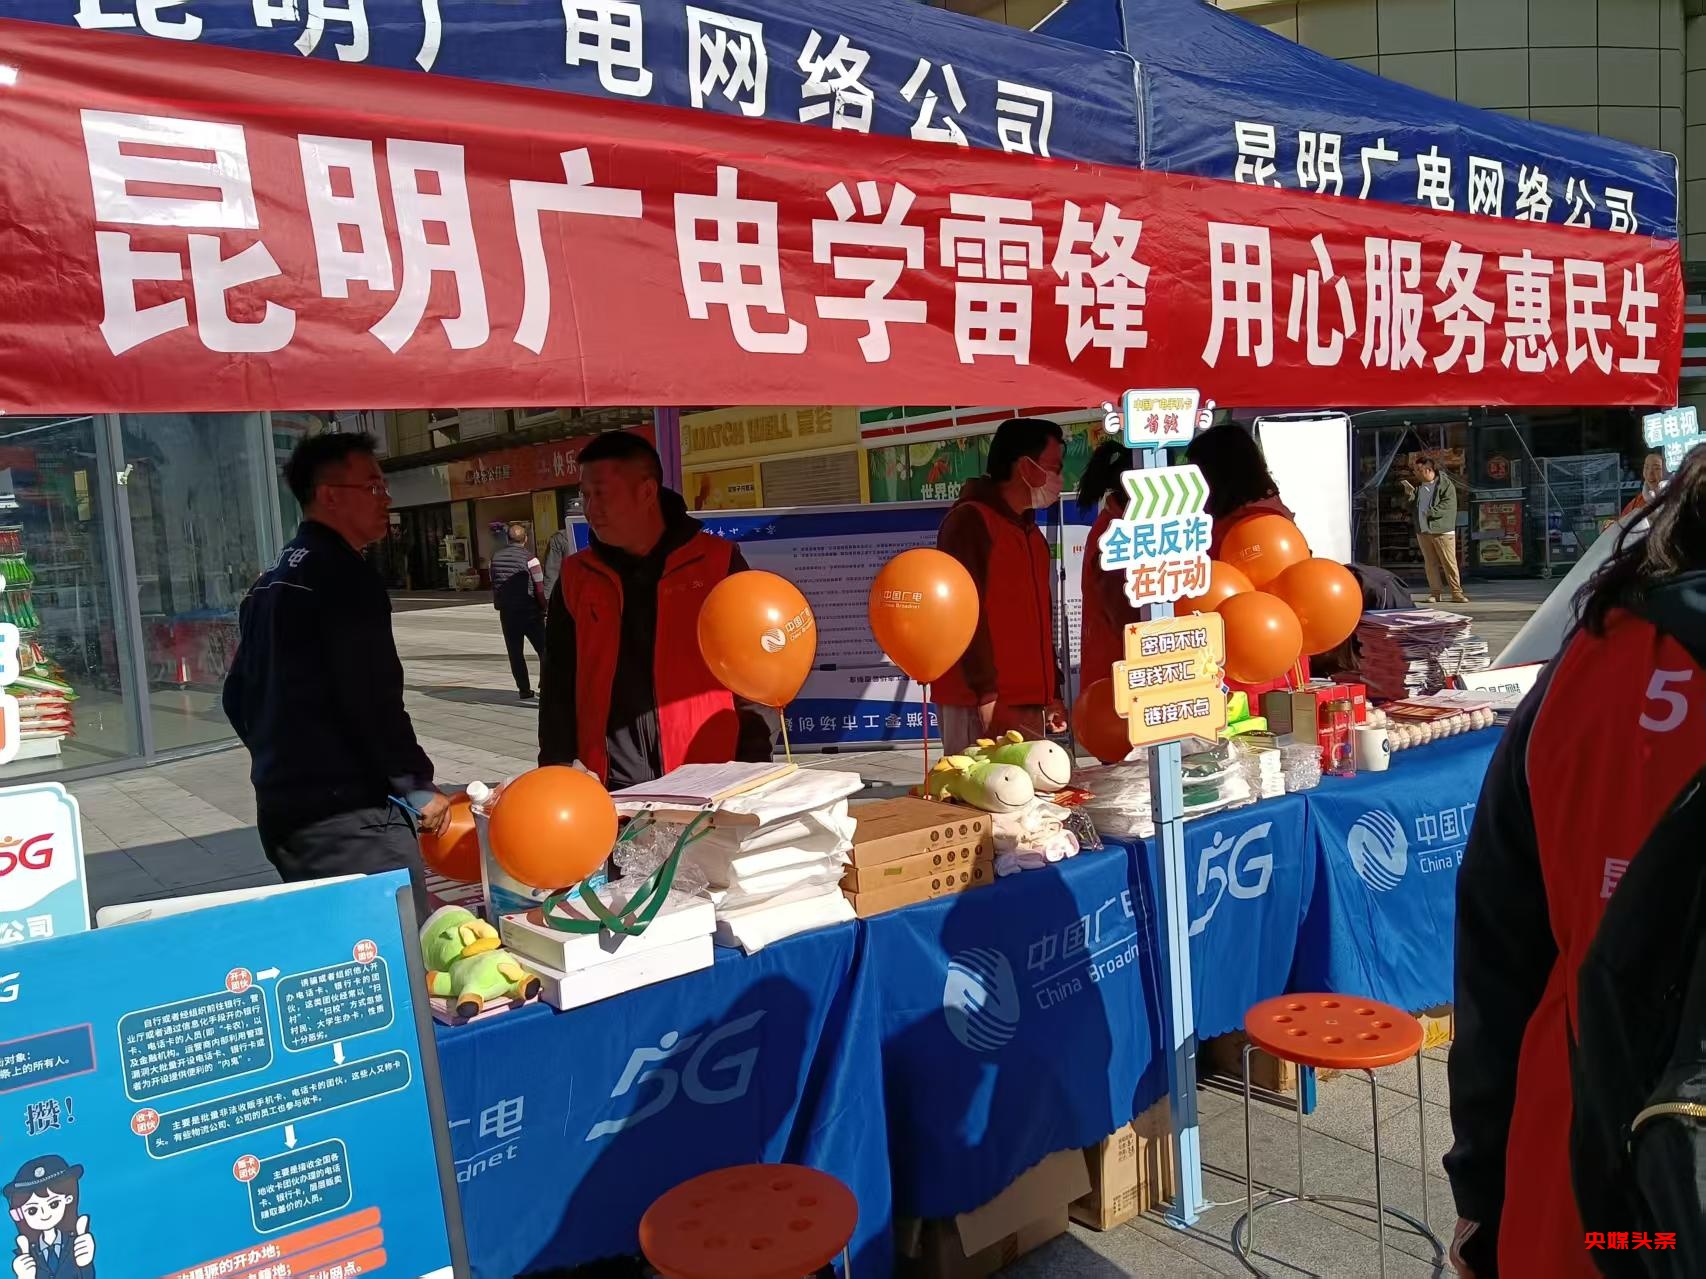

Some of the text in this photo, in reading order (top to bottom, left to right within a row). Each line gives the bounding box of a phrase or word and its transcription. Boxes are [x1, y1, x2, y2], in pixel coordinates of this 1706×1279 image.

[1235, 120, 1637, 236] 昆明广电网络公司
[80, 108, 1662, 376] 昆明广电学雷锋 用心服务惠民生
[1144, 413, 1180, 434] 省钱
[1646, 410, 1697, 443] 看电视
[1105, 516, 1208, 564] 全民反诈
[1131, 556, 1206, 600] 在行动
[883, 590, 922, 602] 中国广电
[1141, 628, 1207, 656] 密码不说
[1128, 660, 1195, 689] 要钱不汇
[1144, 697, 1210, 727] 链接不点
[1638, 668, 1694, 732] 5
[1187, 821, 1274, 938] 5G
[1419, 855, 1453, 873] China
[1036, 977, 1083, 1010] China
[585, 1010, 767, 1142] 5G
